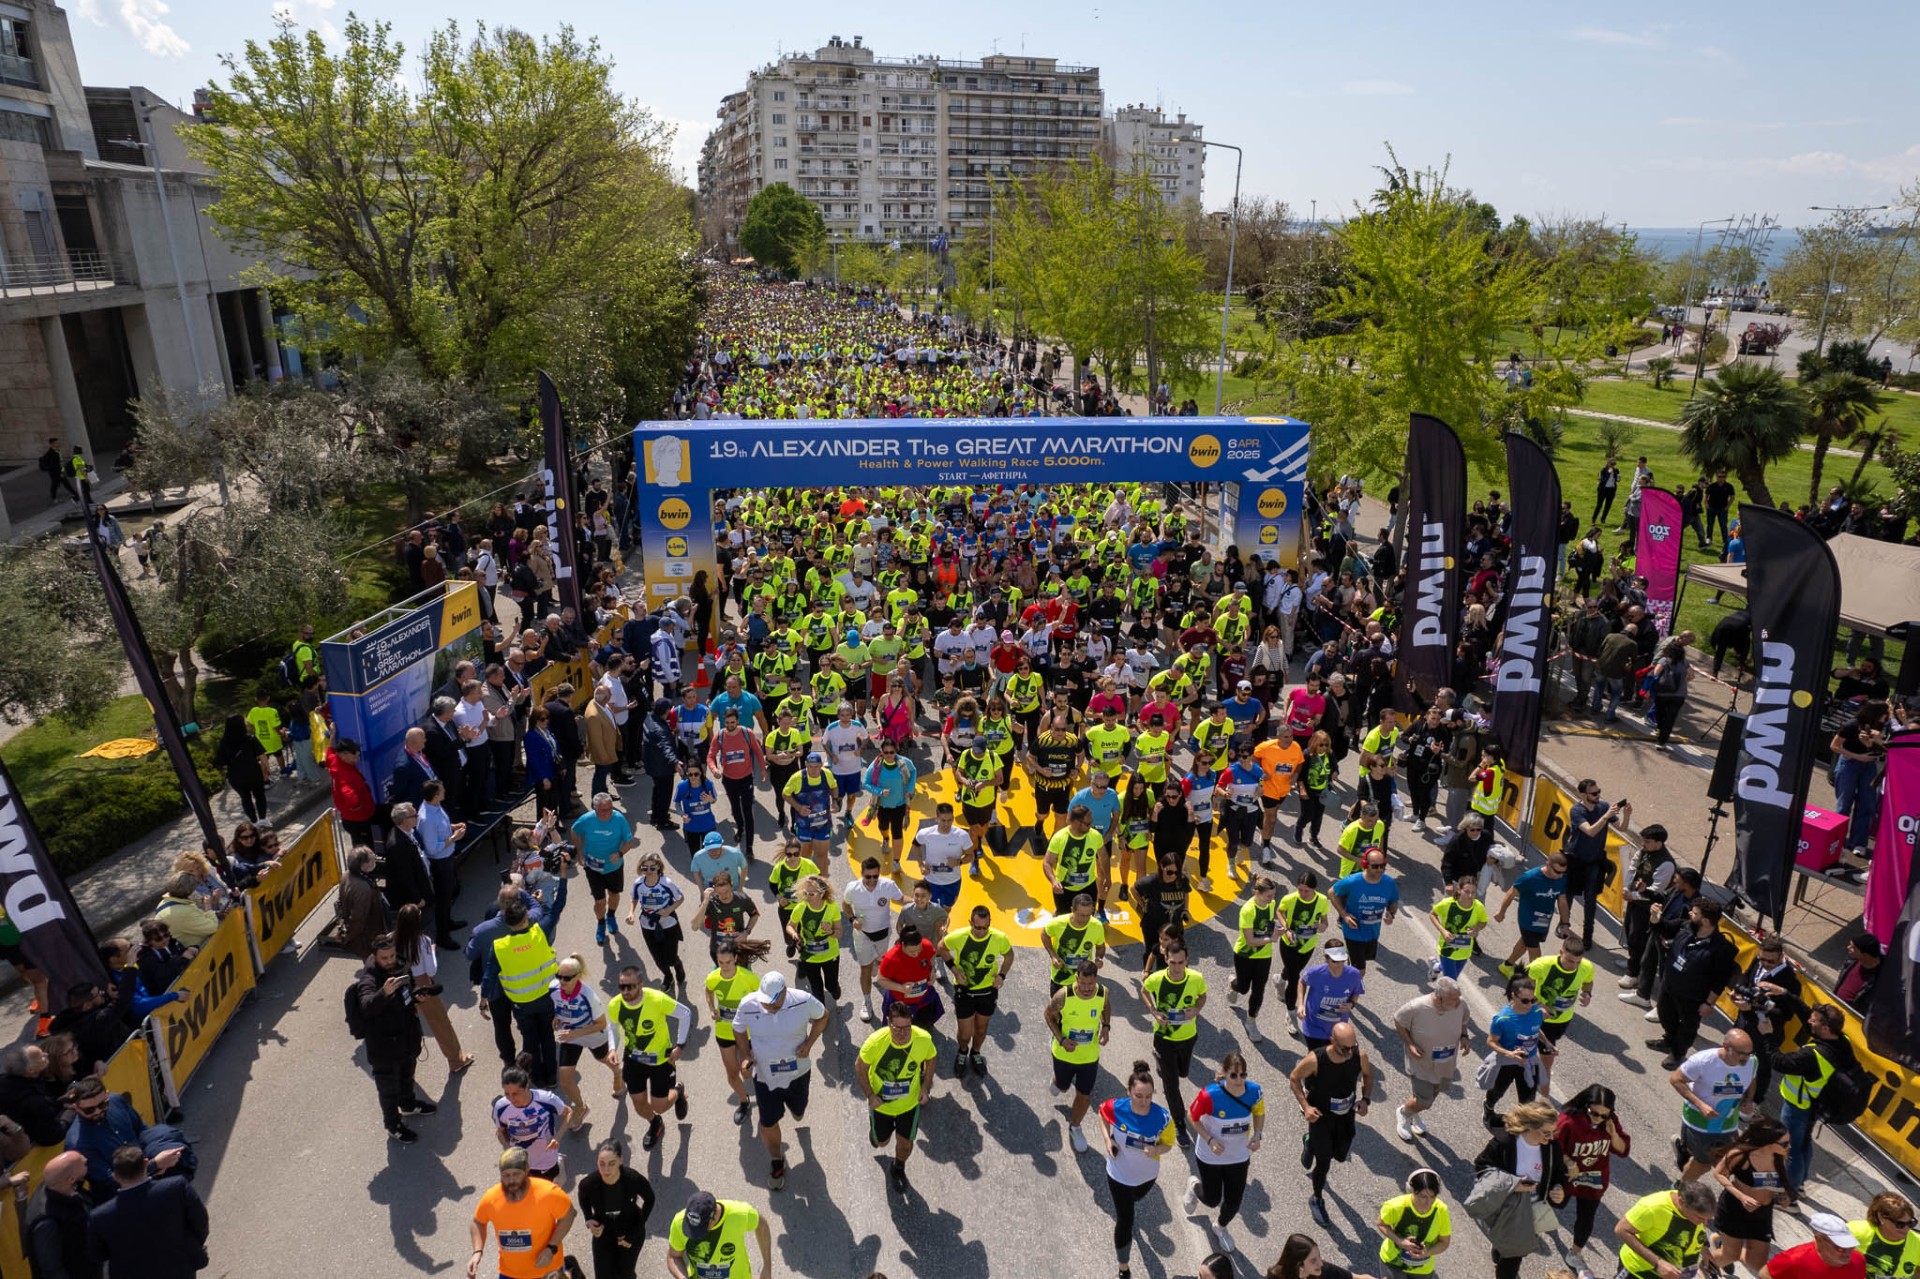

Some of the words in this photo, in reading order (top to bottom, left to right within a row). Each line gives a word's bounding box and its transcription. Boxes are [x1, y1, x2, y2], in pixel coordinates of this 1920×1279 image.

[710, 441, 747, 458] 19th
[751, 439, 900, 458] ALEXANDER
[907, 438, 949, 455] The
[955, 438, 1037, 454] GREAT
[1040, 437, 1183, 453] MARATHON
[1190, 445, 1219, 457] bwin
[1228, 439, 1236, 448] 6
[1238, 439, 1260, 448] APR.
[859, 459, 899, 469] Health
[903, 459, 913, 468] &
[917, 458, 954, 469] Power
[959, 457, 1007, 469] Walking
[1011, 457, 1040, 467] Race
[1044, 456, 1105, 467] 5.000m.
[1227, 450, 1260, 459] 2025
[938, 472, 968, 481] START
[1259, 498, 1284, 509] bwin
[660, 508, 689, 519] bwin
[451, 605, 472, 626] bwin
[389, 619, 430, 647] ALEXANDER
[377, 650, 403, 670] GREAT
[380, 648, 421, 677] MARATHON
[258, 849, 323, 942] bwin
[168, 952, 234, 1070] bwin
